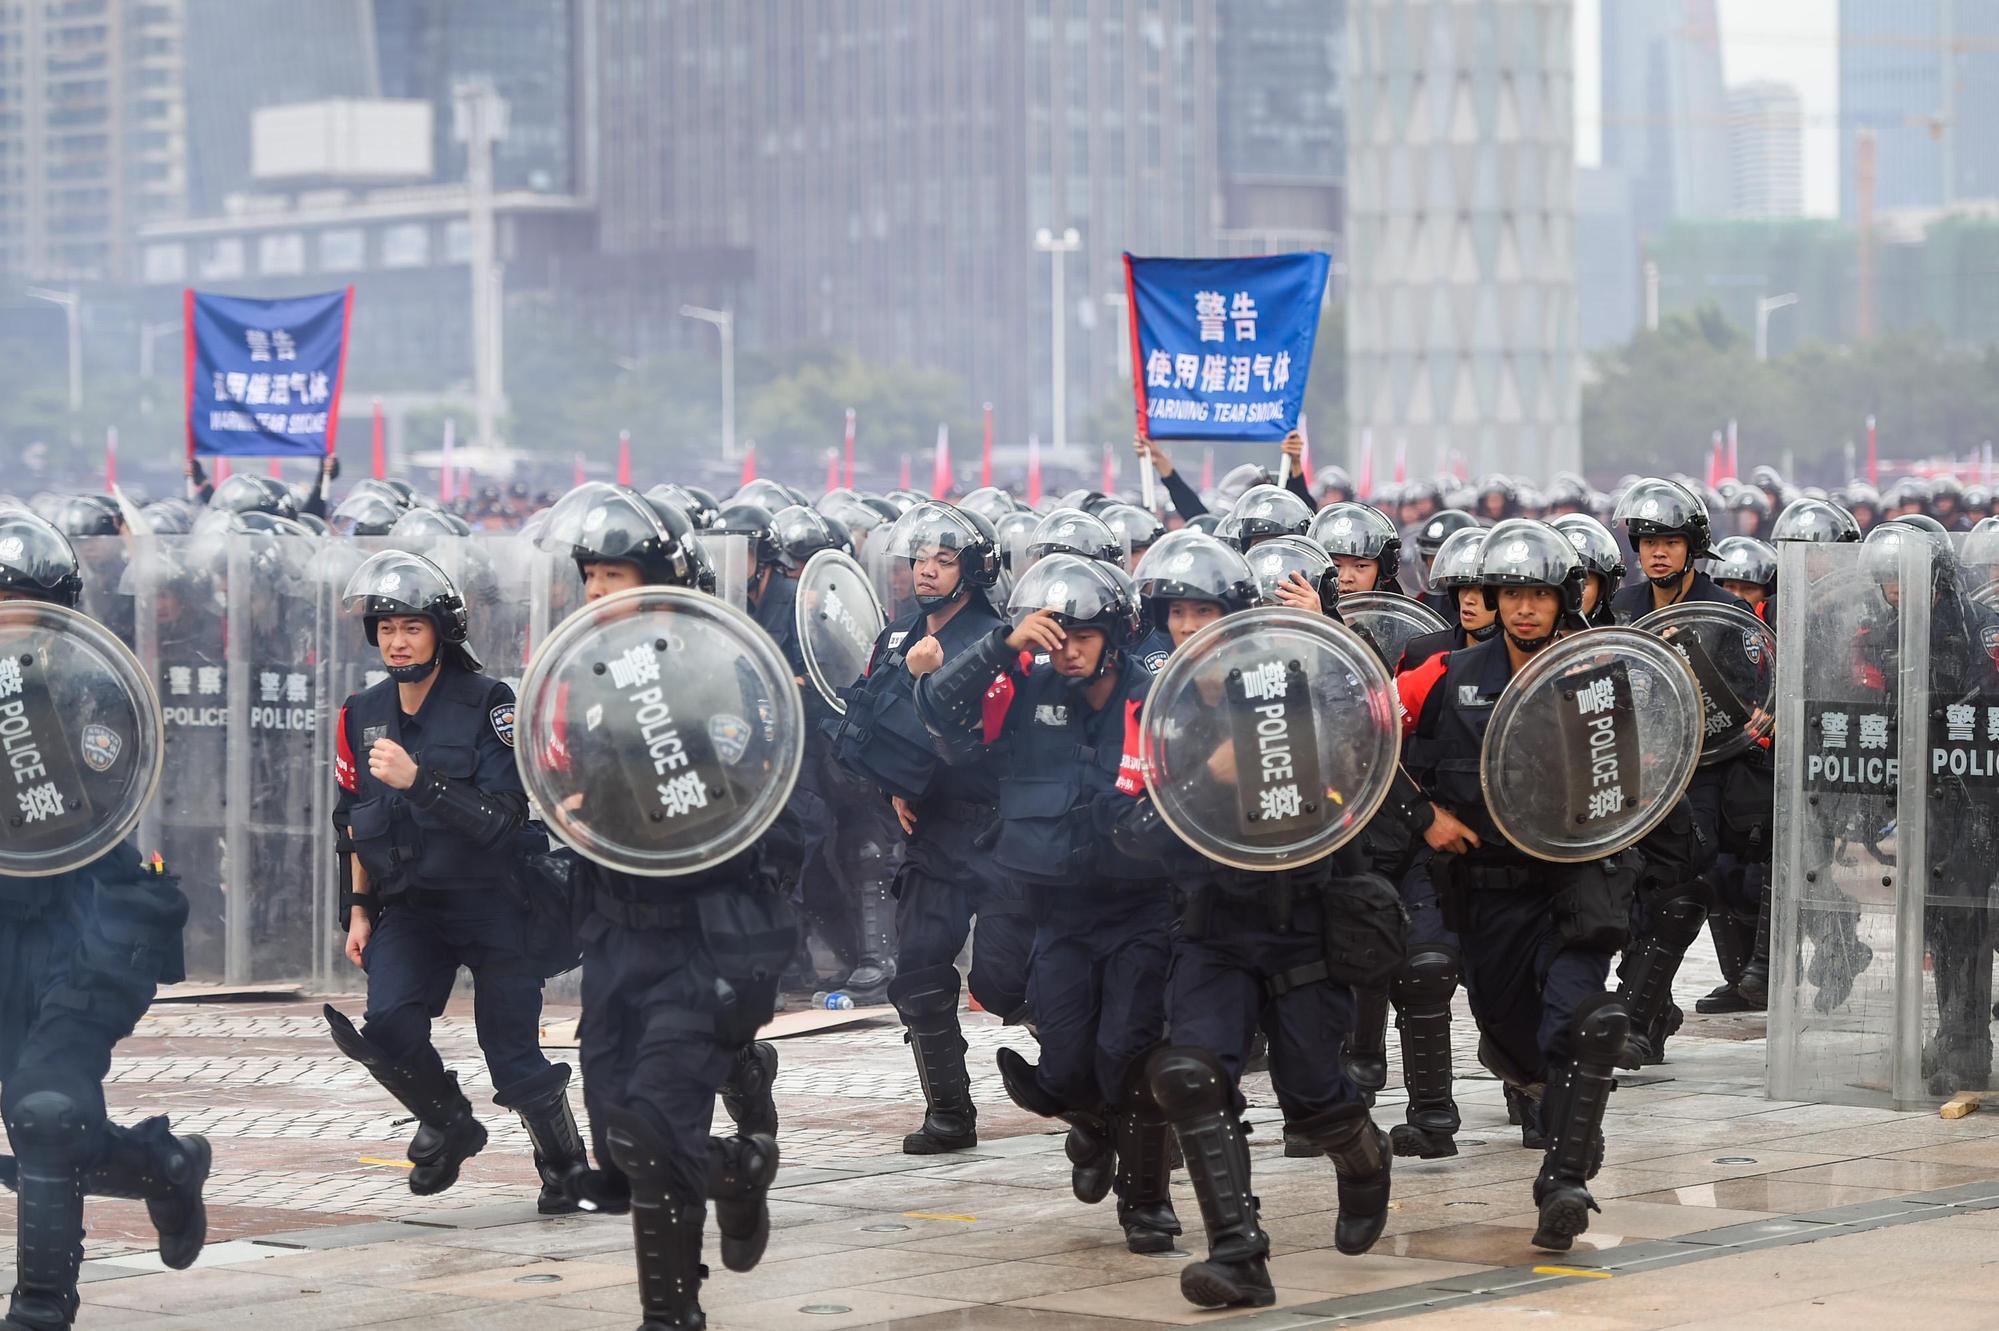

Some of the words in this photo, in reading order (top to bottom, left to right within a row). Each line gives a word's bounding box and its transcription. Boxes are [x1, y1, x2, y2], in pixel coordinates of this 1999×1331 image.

[1194, 290, 1258, 342] 警告
[1146, 348, 1292, 393] 使用催泪气体
[608, 642, 660, 690] 警
[1242, 660, 1288, 700] 警
[1576, 676, 1616, 715] 警
[251, 706, 316, 731] POLICE
[629, 686, 689, 776] POLICE
[1821, 711, 1889, 750] 警察
[0, 700, 47, 784] POLICE
[1254, 703, 1294, 783] POLICE
[1587, 715, 1619, 787] POLICE
[1932, 748, 1999, 777] POLI
[17, 781, 65, 823] 察
[657, 770, 708, 818] 察
[1260, 784, 1303, 820] 察
[1588, 785, 1624, 819] 察
